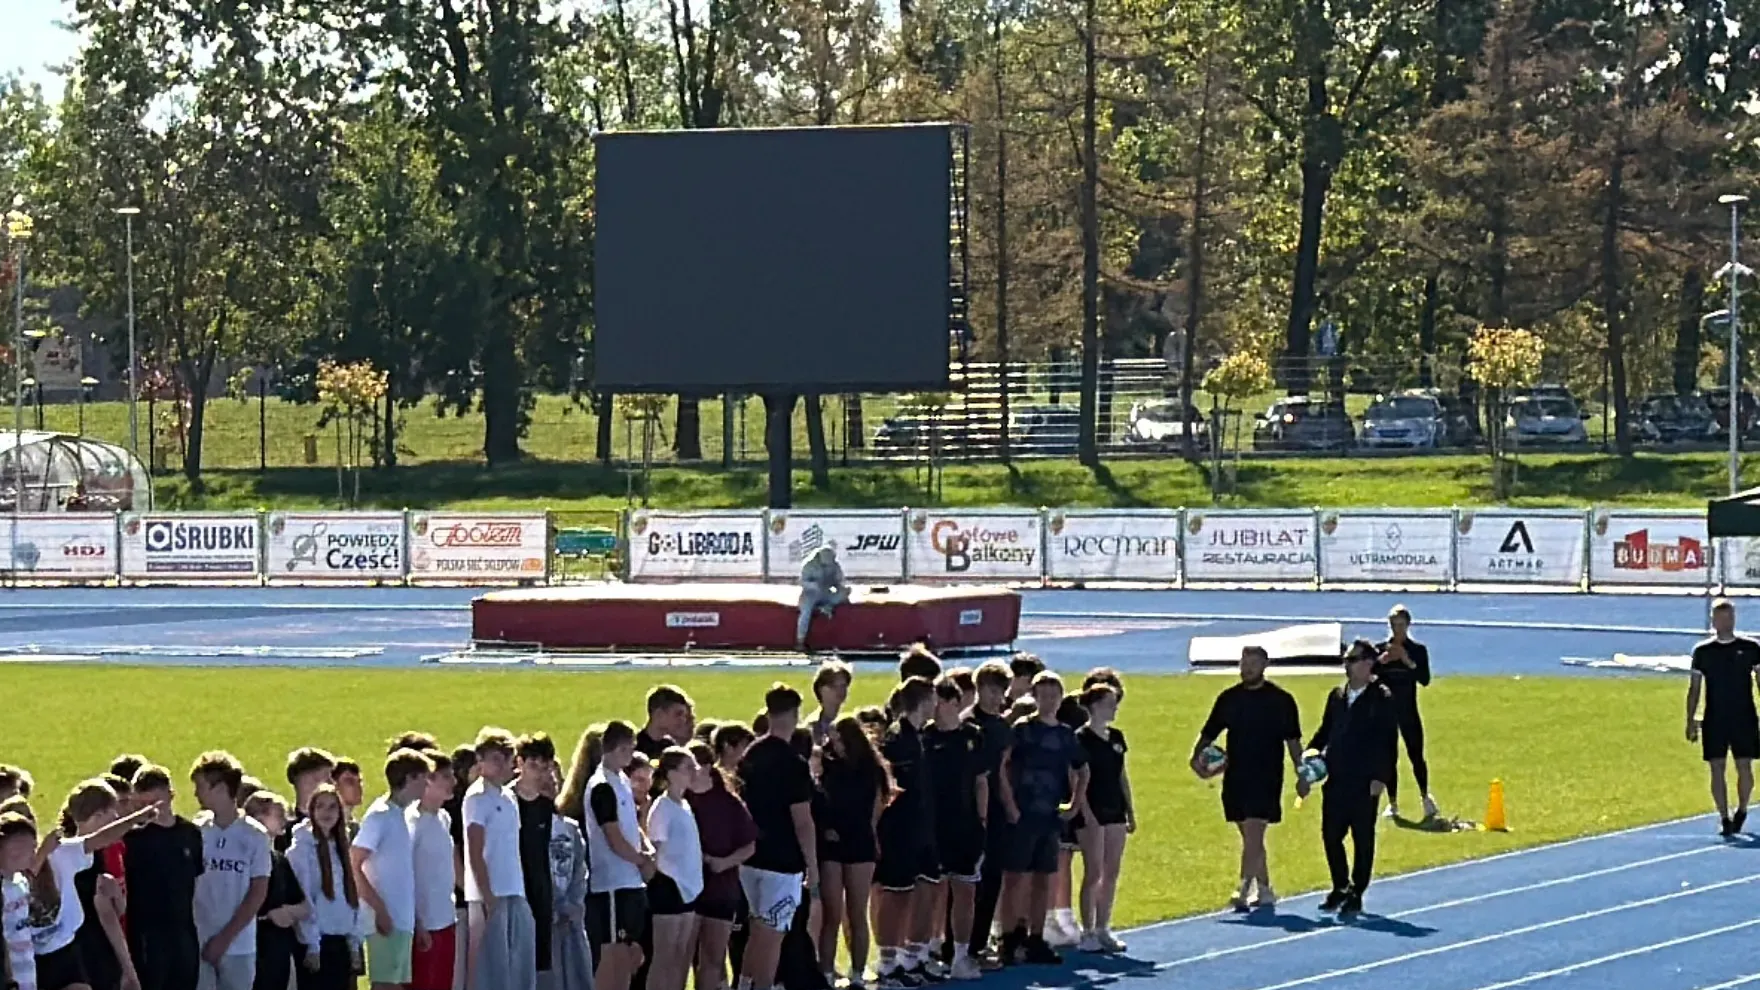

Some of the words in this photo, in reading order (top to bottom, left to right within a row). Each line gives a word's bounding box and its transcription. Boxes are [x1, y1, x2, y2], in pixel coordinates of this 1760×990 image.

[175, 520, 254, 551] ŚRUBKI
[328, 534, 399, 548] POWIEDZ
[326, 547, 399, 569] Cześć!
